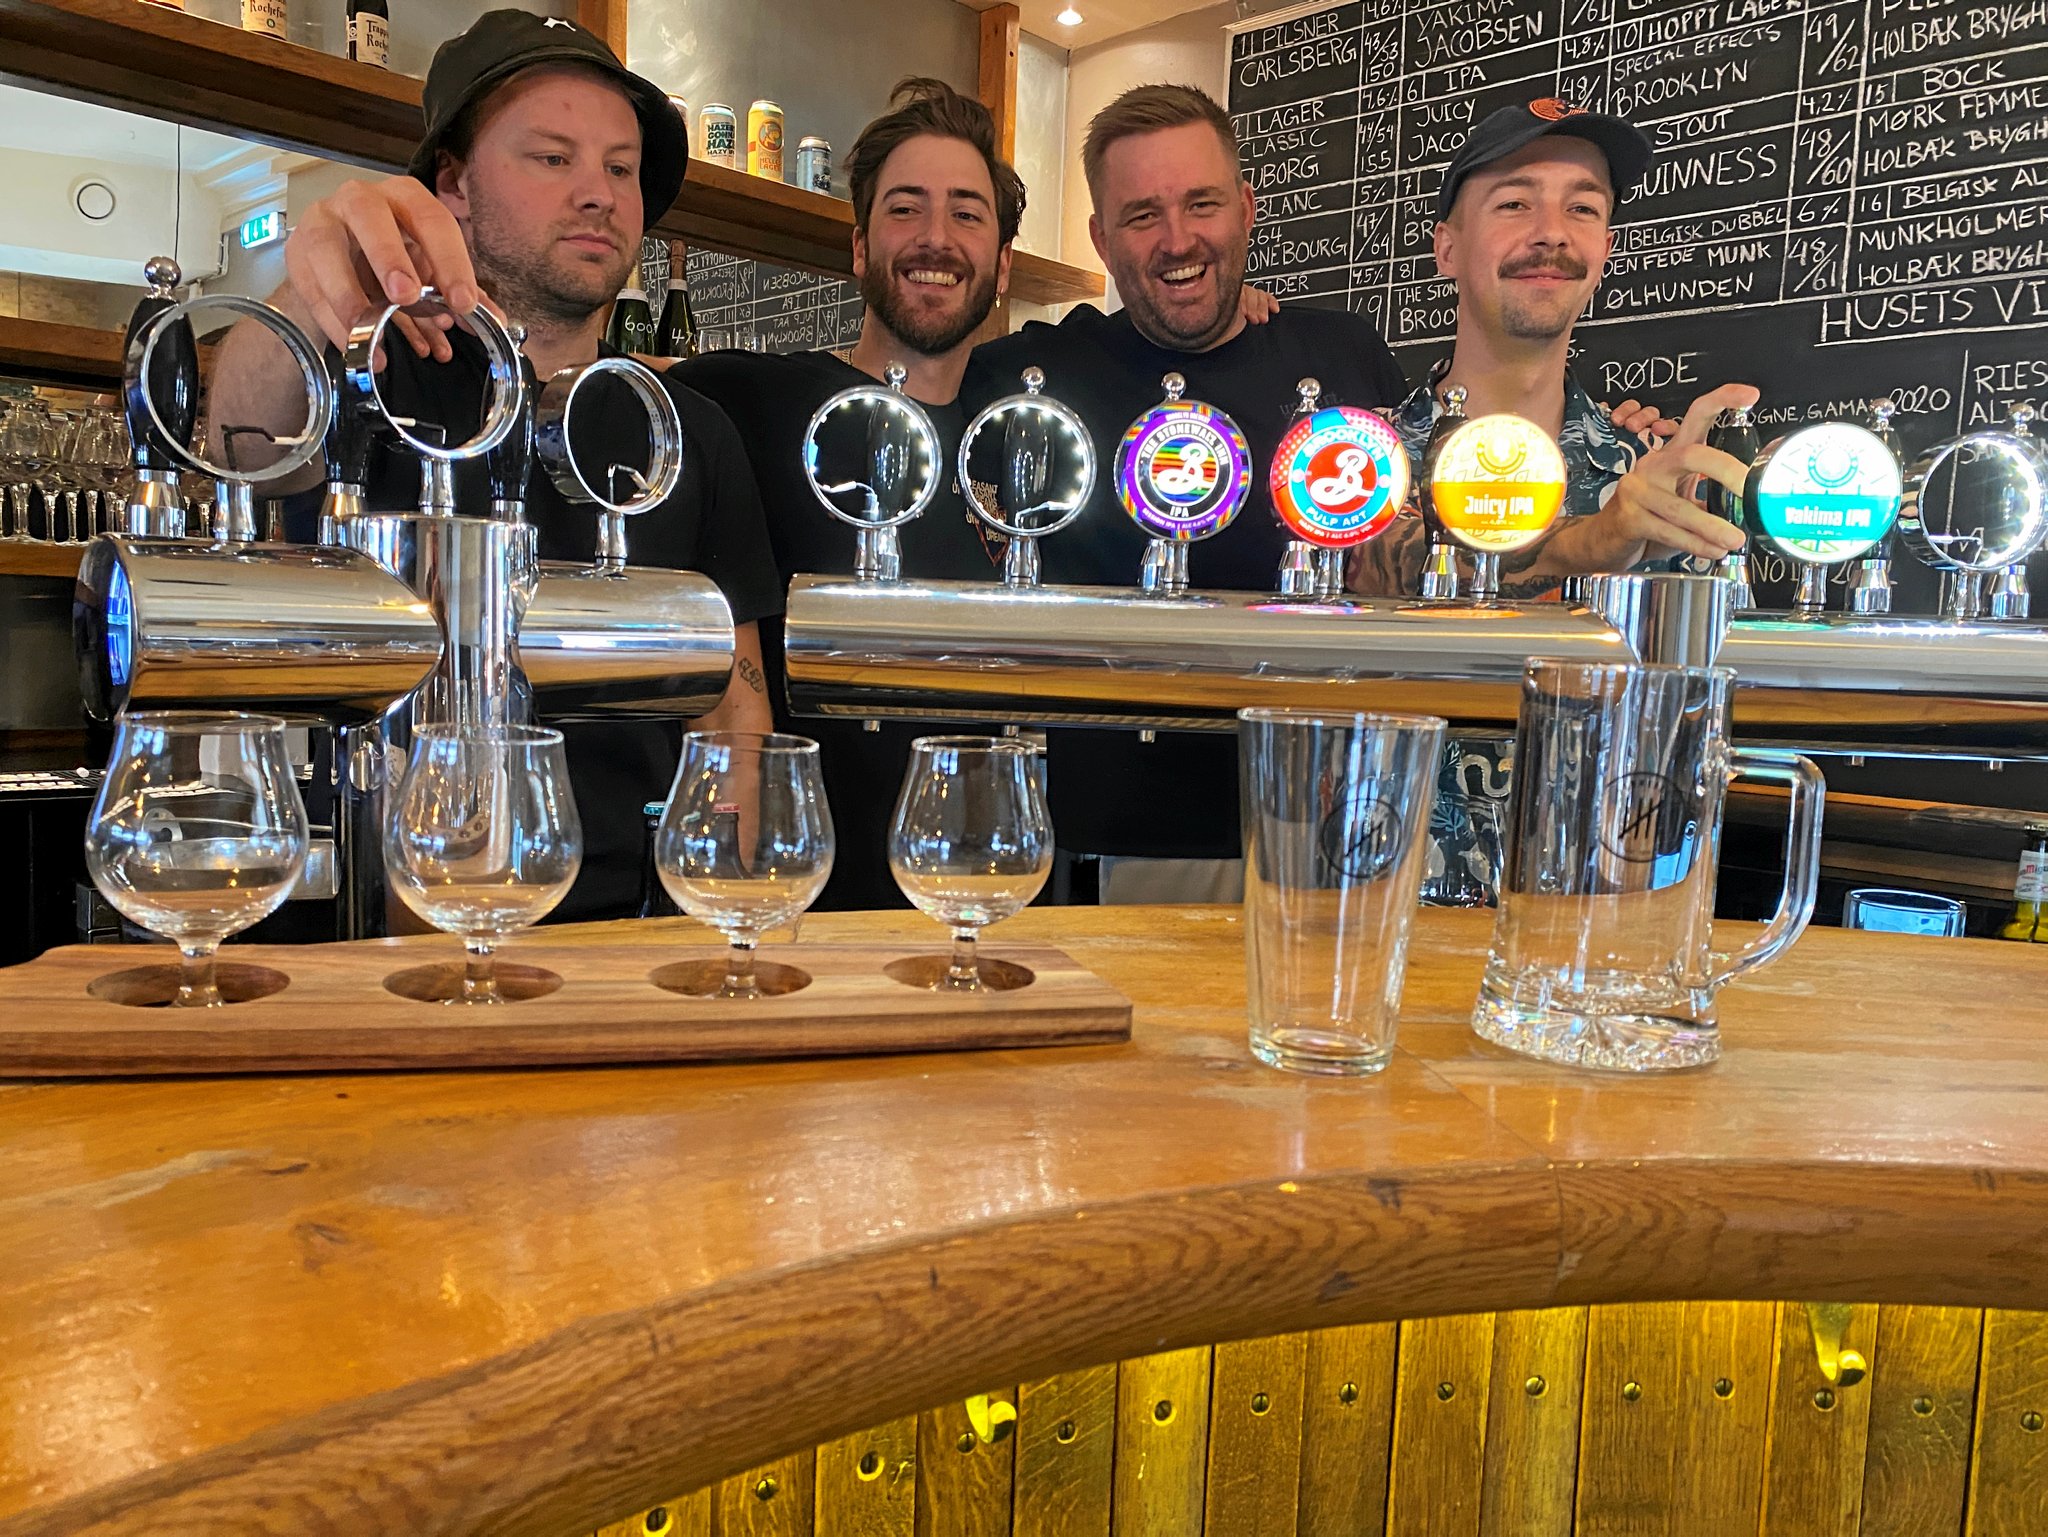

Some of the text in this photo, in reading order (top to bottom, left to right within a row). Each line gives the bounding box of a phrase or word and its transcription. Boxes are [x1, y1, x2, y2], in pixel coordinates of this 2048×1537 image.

[1262, 13, 1340, 52] PILSNER
[1415, 11, 1543, 68] JACOBSEN
[1649, 5, 1717, 43] HOPPY
[1872, 15, 1962, 64] HOLBÆK
[1240, 37, 1357, 87] CARLSBERG
[1613, 24, 1782, 82] SPECIAL EFFECTS
[1365, 62, 1395, 83] 150
[1406, 65, 1487, 101] 6 IPA
[1611, 59, 1748, 118] BROOKLYN
[1866, 60, 2006, 106] 15 BOCK
[1257, 101, 1325, 134] LAGER
[1412, 99, 1476, 128] JUICY
[1655, 109, 1734, 146] STOUT
[1869, 87, 2048, 139] MØRK FEMME
[1238, 128, 1328, 161] CLASSIC
[1361, 150, 1392, 172] 155
[1863, 136, 1957, 177] HOLBÆK
[1254, 192, 1322, 222] BLANC
[1861, 194, 1882, 213] 16
[1902, 176, 1998, 210] BELGISK
[1629, 223, 1705, 250] BELGISK
[1711, 207, 1788, 235] DUBBEL
[1246, 237, 1348, 272] ONEBOURG
[1400, 263, 1411, 279] 8
[1602, 241, 1772, 278] DEN FEDE MUNK
[1858, 252, 1963, 288] HOLBÆK
[1394, 286, 1421, 306] THE
[1604, 272, 1754, 310] ØLHUNDEN
[1399, 305, 1459, 334] BROO
[1821, 287, 1977, 343] HUSETS
[1599, 351, 1699, 393] RØDE
[1807, 399, 1873, 420] GAMA
[1302, 428, 1386, 460] BROOKLYN
[1170, 505, 1190, 518] IPA
[1306, 506, 1367, 527] PULP ART
[1464, 493, 1534, 521] Juicy IPA
[1785, 505, 1872, 528] Yakima IPA
